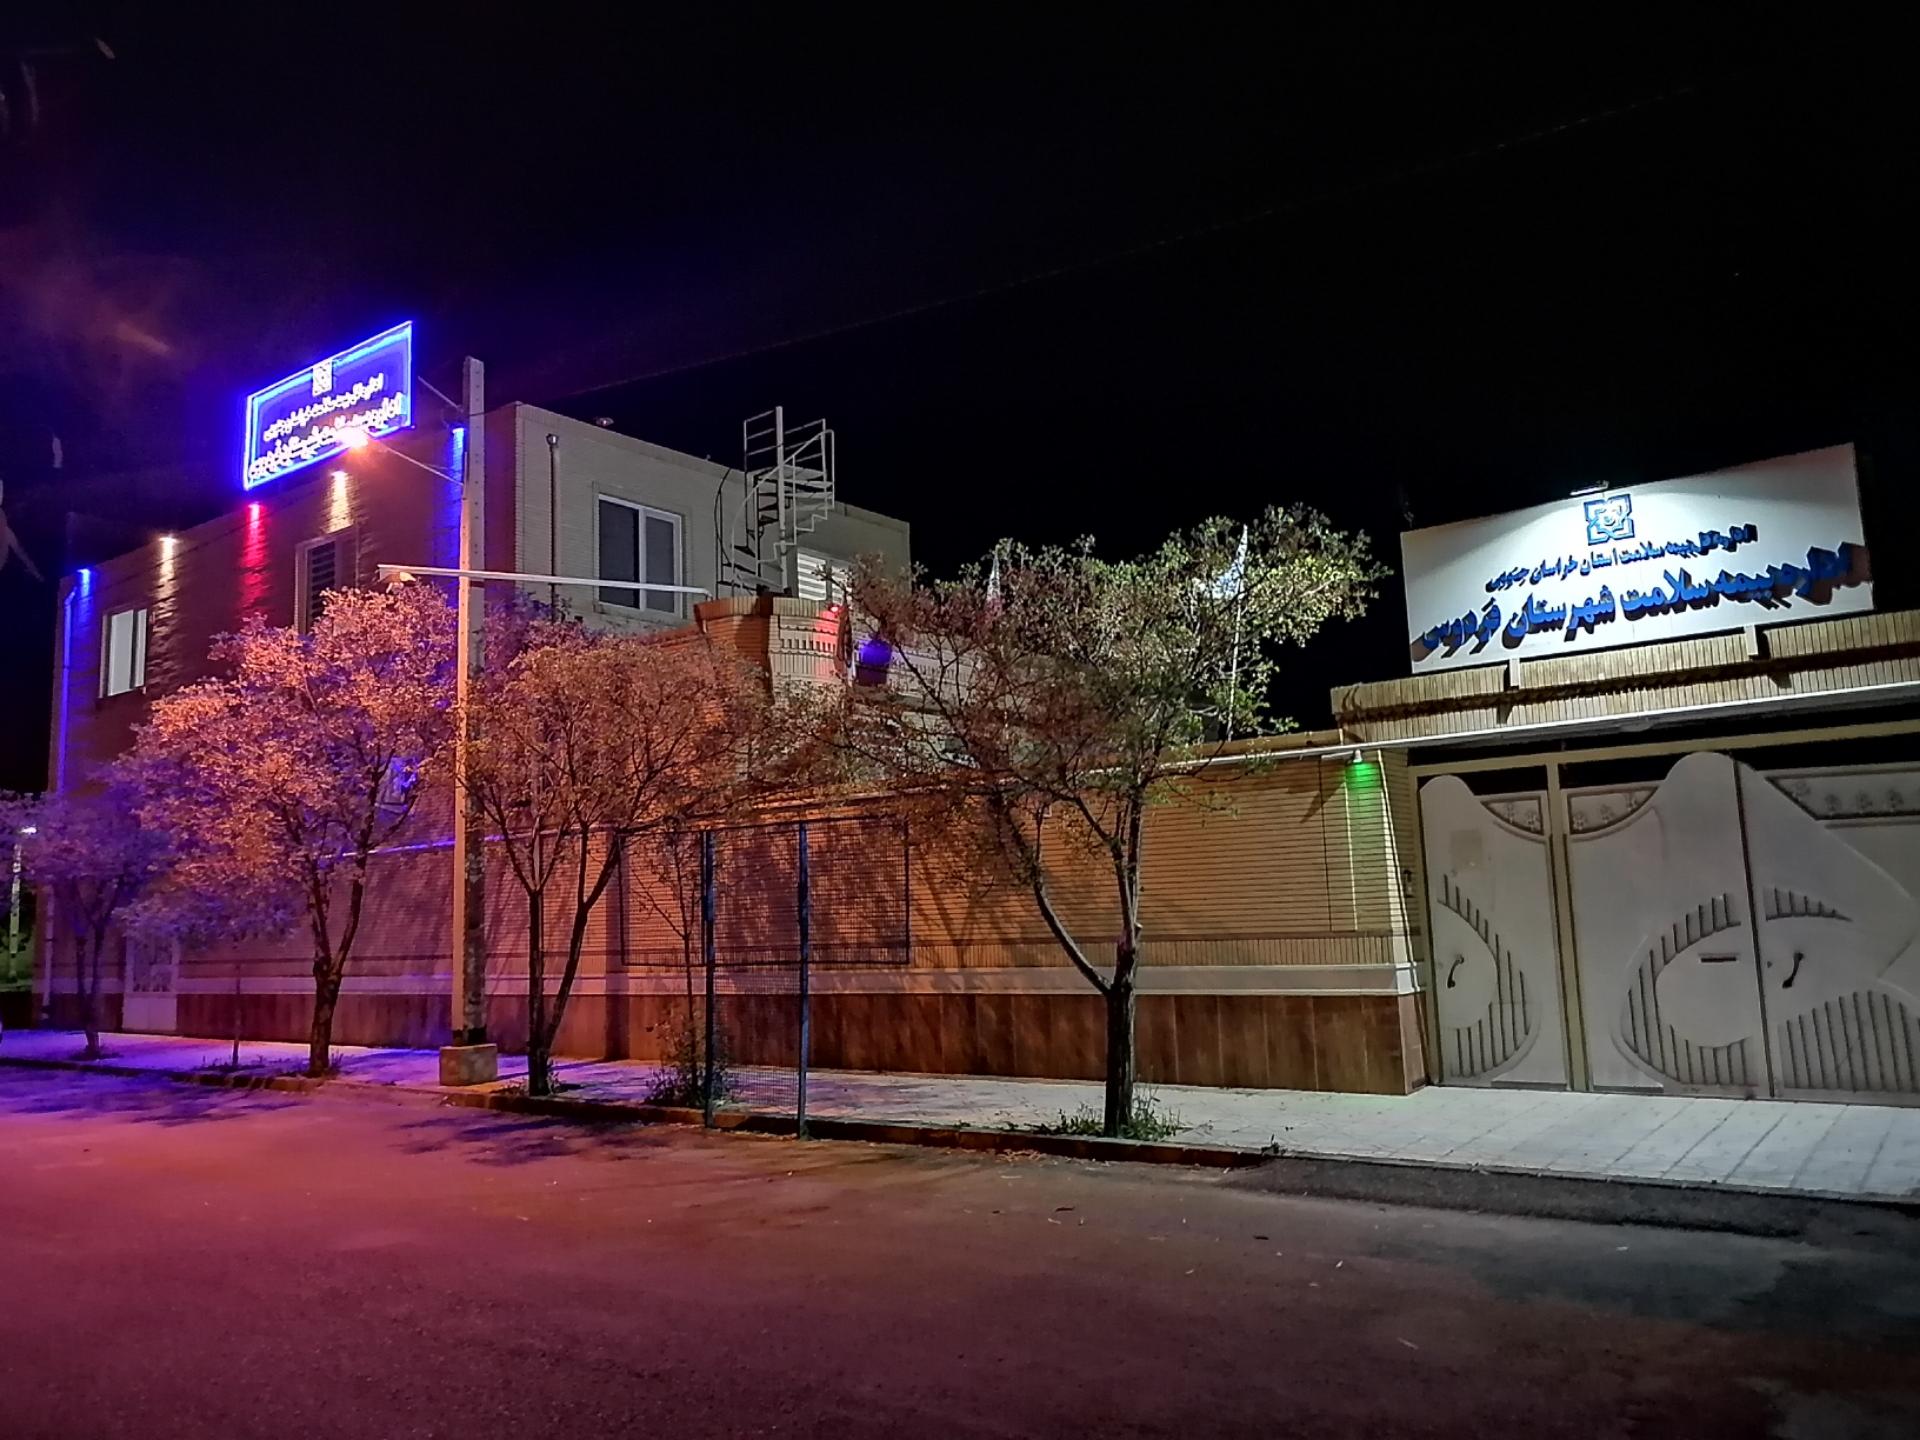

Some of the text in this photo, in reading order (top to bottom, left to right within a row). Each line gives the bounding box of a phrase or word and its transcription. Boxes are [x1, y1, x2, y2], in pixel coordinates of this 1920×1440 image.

[1580, 547, 1618, 577] استان
[1619, 541, 1666, 565] سلامت
[1665, 539, 1699, 559] بیمه
[1485, 567, 1530, 593] جنوبی
[1529, 555, 1578, 585] خراسان
[1620, 567, 1719, 621] سلامت
[1714, 566, 1792, 610] بیمه
[1413, 597, 1502, 660] فردوس
[1503, 585, 1616, 647] شهرستان
